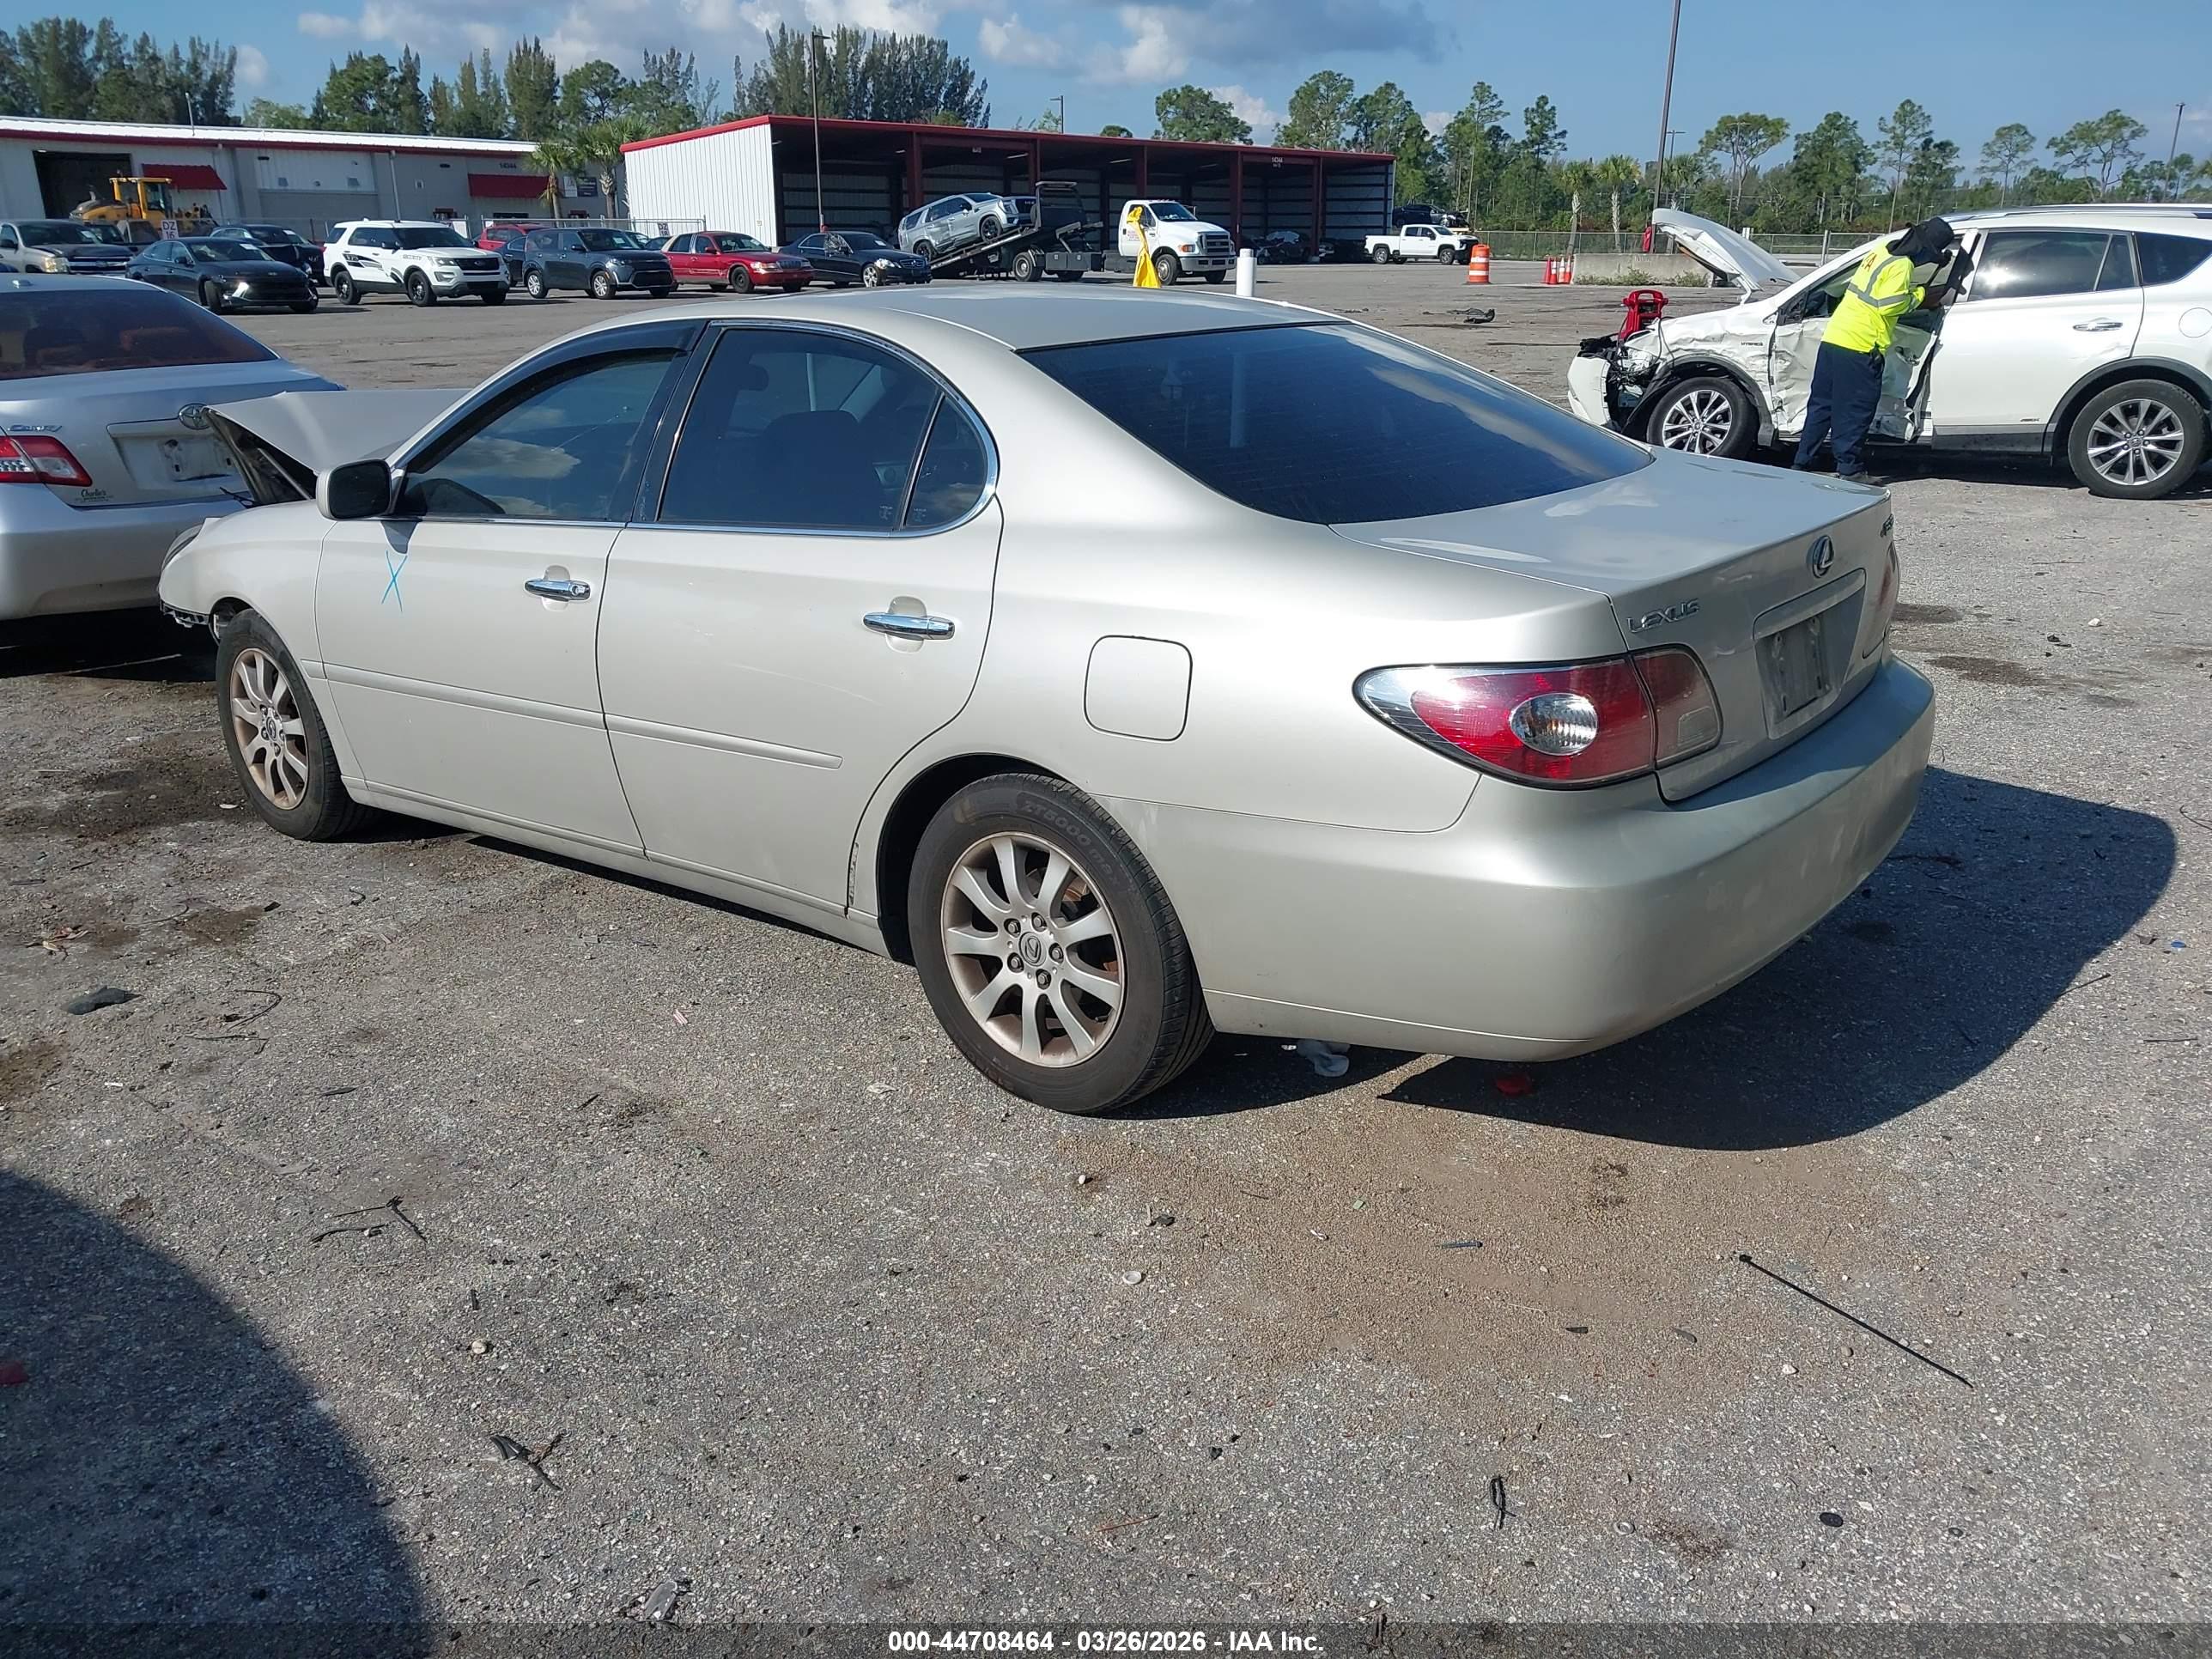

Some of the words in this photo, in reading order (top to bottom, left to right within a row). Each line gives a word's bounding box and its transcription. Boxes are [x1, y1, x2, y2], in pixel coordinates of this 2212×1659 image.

[163, 222, 176, 230] DZ
[1626, 598, 1699, 632] LEXUS
[1022, 799, 1091, 846] ZT5000
